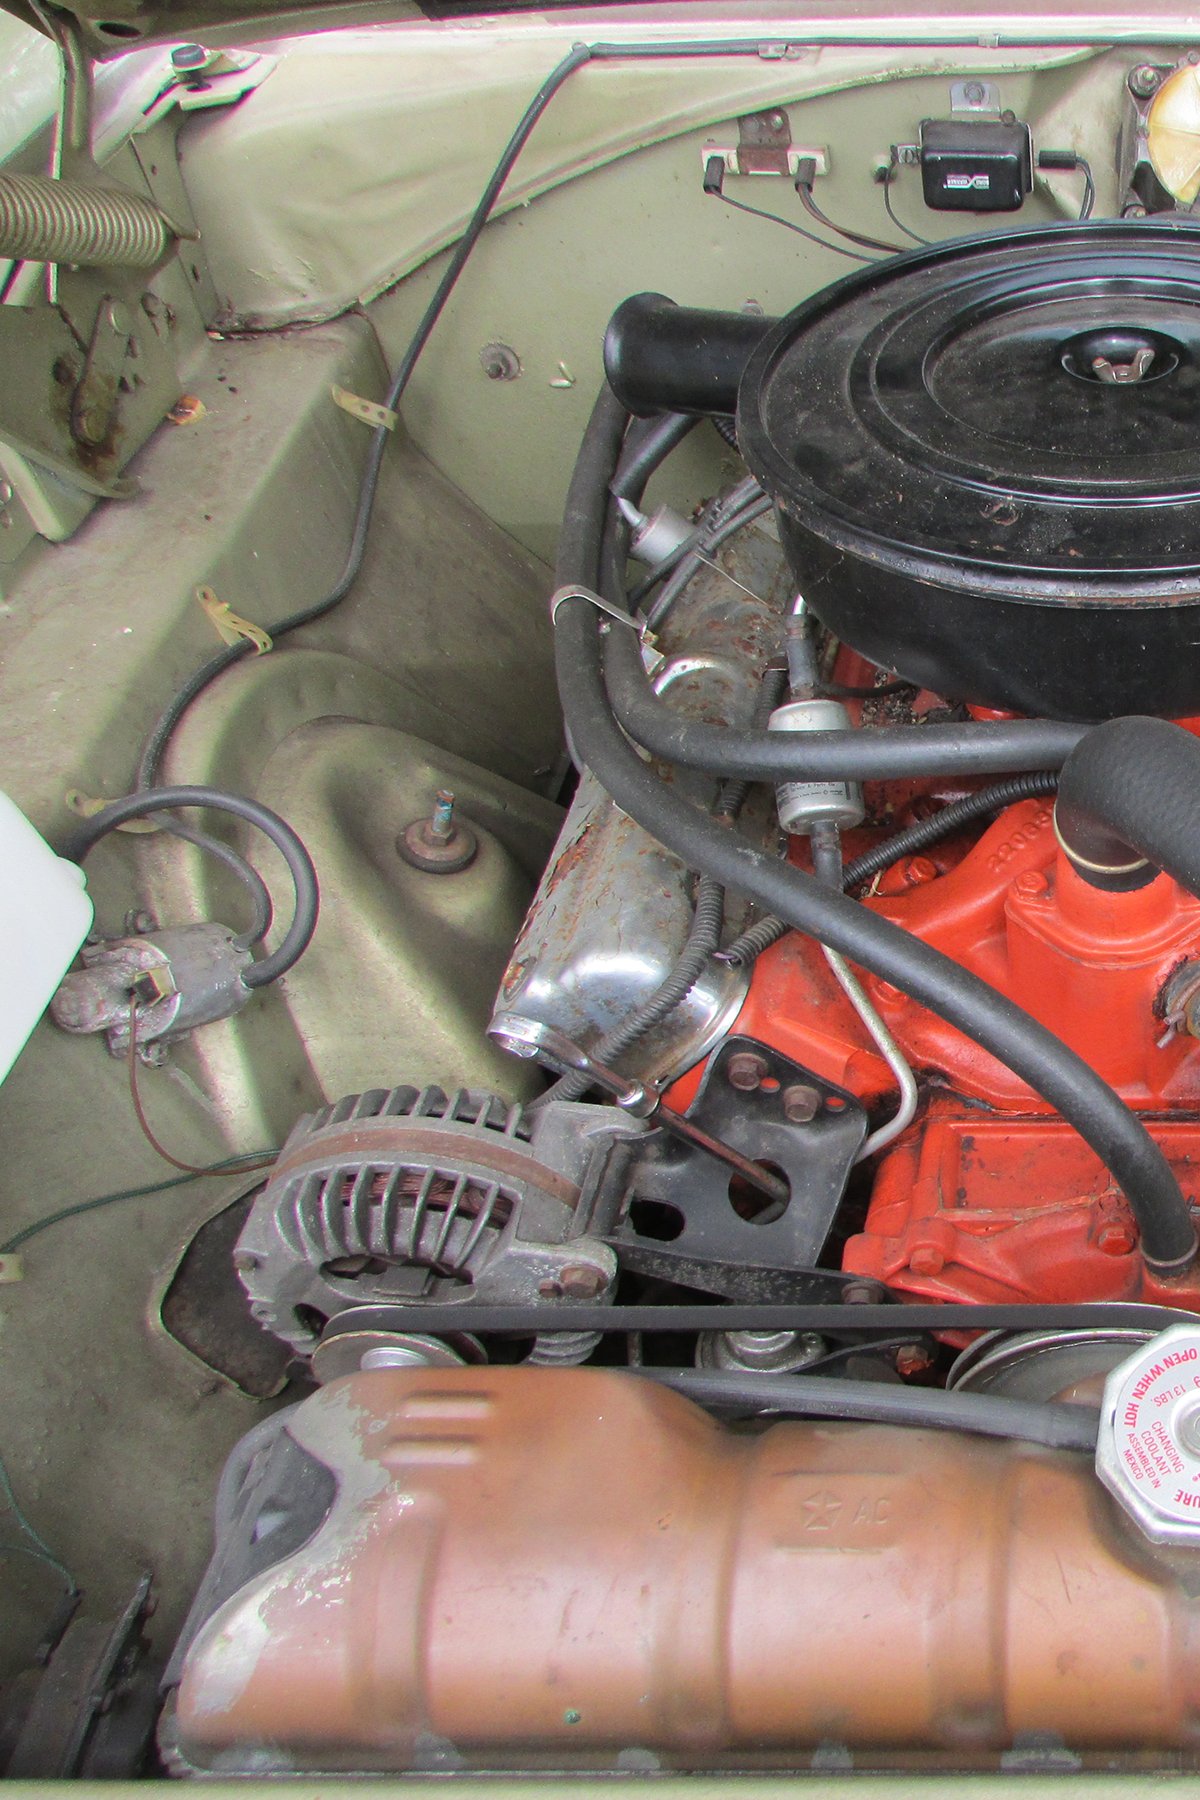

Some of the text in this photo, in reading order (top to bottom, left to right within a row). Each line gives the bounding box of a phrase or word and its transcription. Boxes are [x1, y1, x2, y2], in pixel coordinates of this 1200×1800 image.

[1163, 1347, 1198, 1369] OPEN
[1131, 1364, 1165, 1400] WHEN
[1153, 1384, 1187, 1408] 13 LBS
[1123, 1402, 1140, 1428] HOT
[1126, 1432, 1162, 1489] ASSEMBLED IN
[1140, 1430, 1171, 1476] COOLANT
[1151, 1420, 1185, 1474] CHANGING
[1123, 1449, 1144, 1480] MEXICO
[852, 1497, 888, 1525] AC
